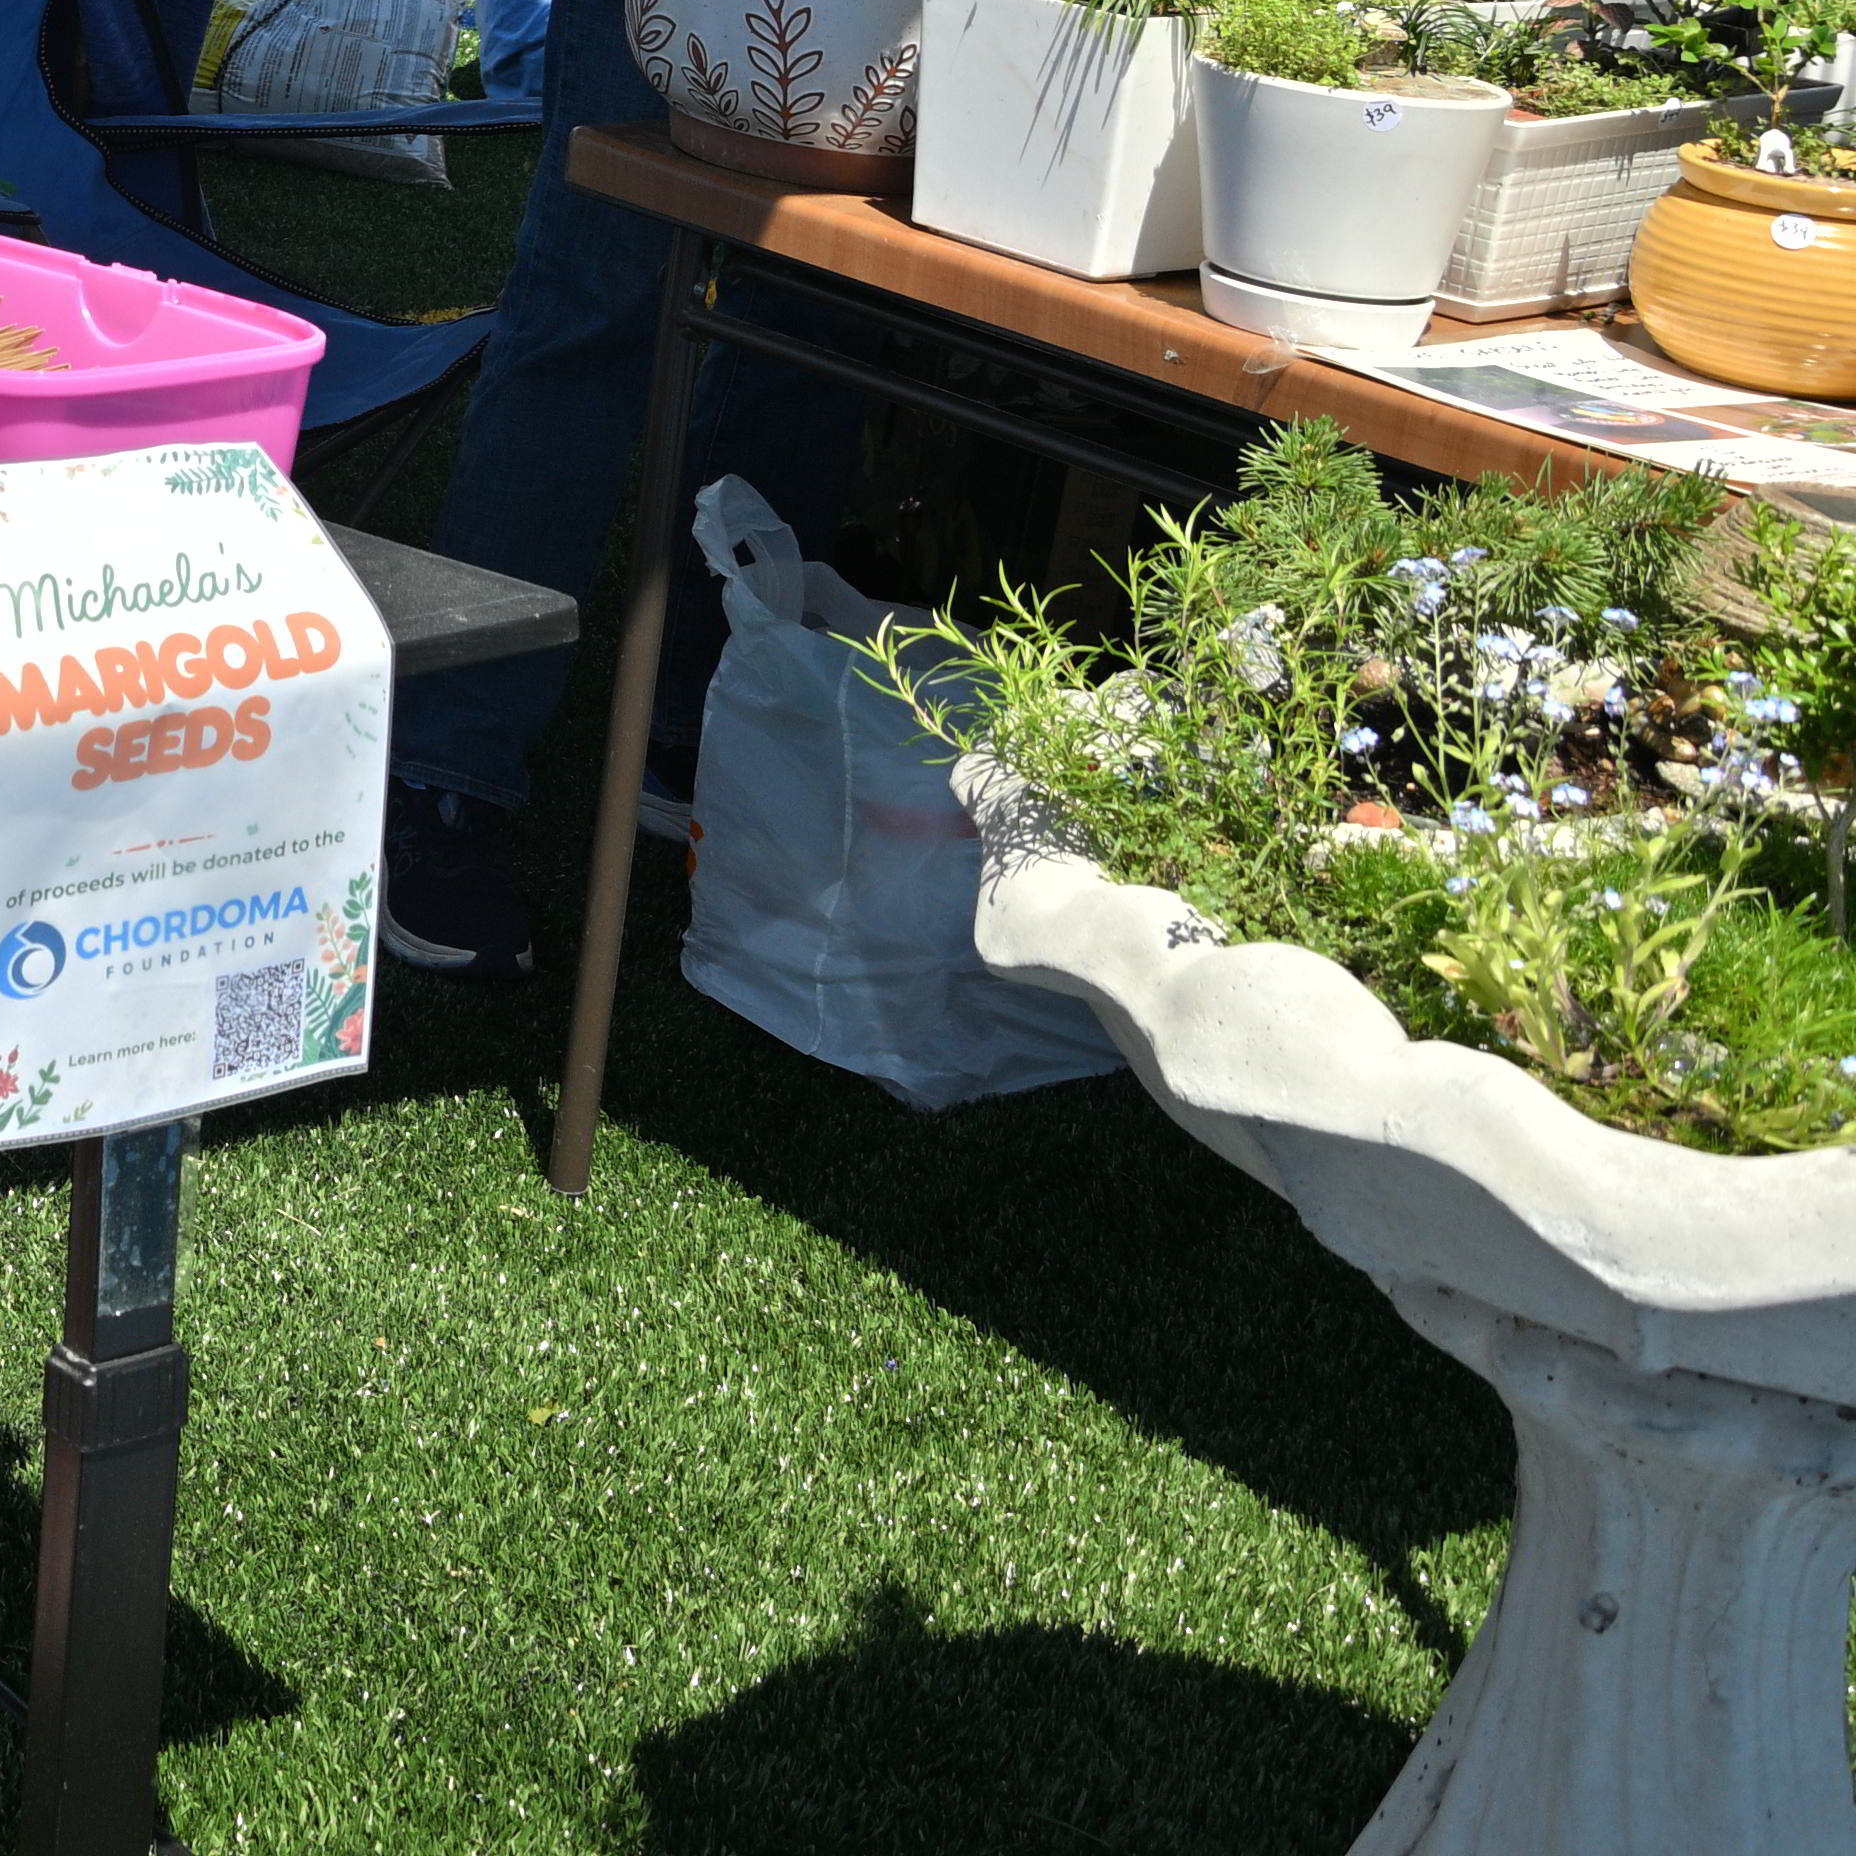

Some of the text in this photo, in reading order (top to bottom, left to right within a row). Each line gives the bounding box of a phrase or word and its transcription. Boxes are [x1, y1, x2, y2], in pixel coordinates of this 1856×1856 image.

[71, 696, 272, 791] SEEDS
[6, 890, 27, 910] of
[29, 870, 125, 907] proceeds
[131, 862, 166, 885] will
[172, 857, 196, 877] be
[202, 842, 286, 872] donated
[291, 835, 310, 854] to
[314, 829, 346, 850] the
[74, 885, 310, 960] CHORDOMA
[104, 930, 276, 980] FOUNDATION
[68, 1031, 197, 1069] Learn more here:
